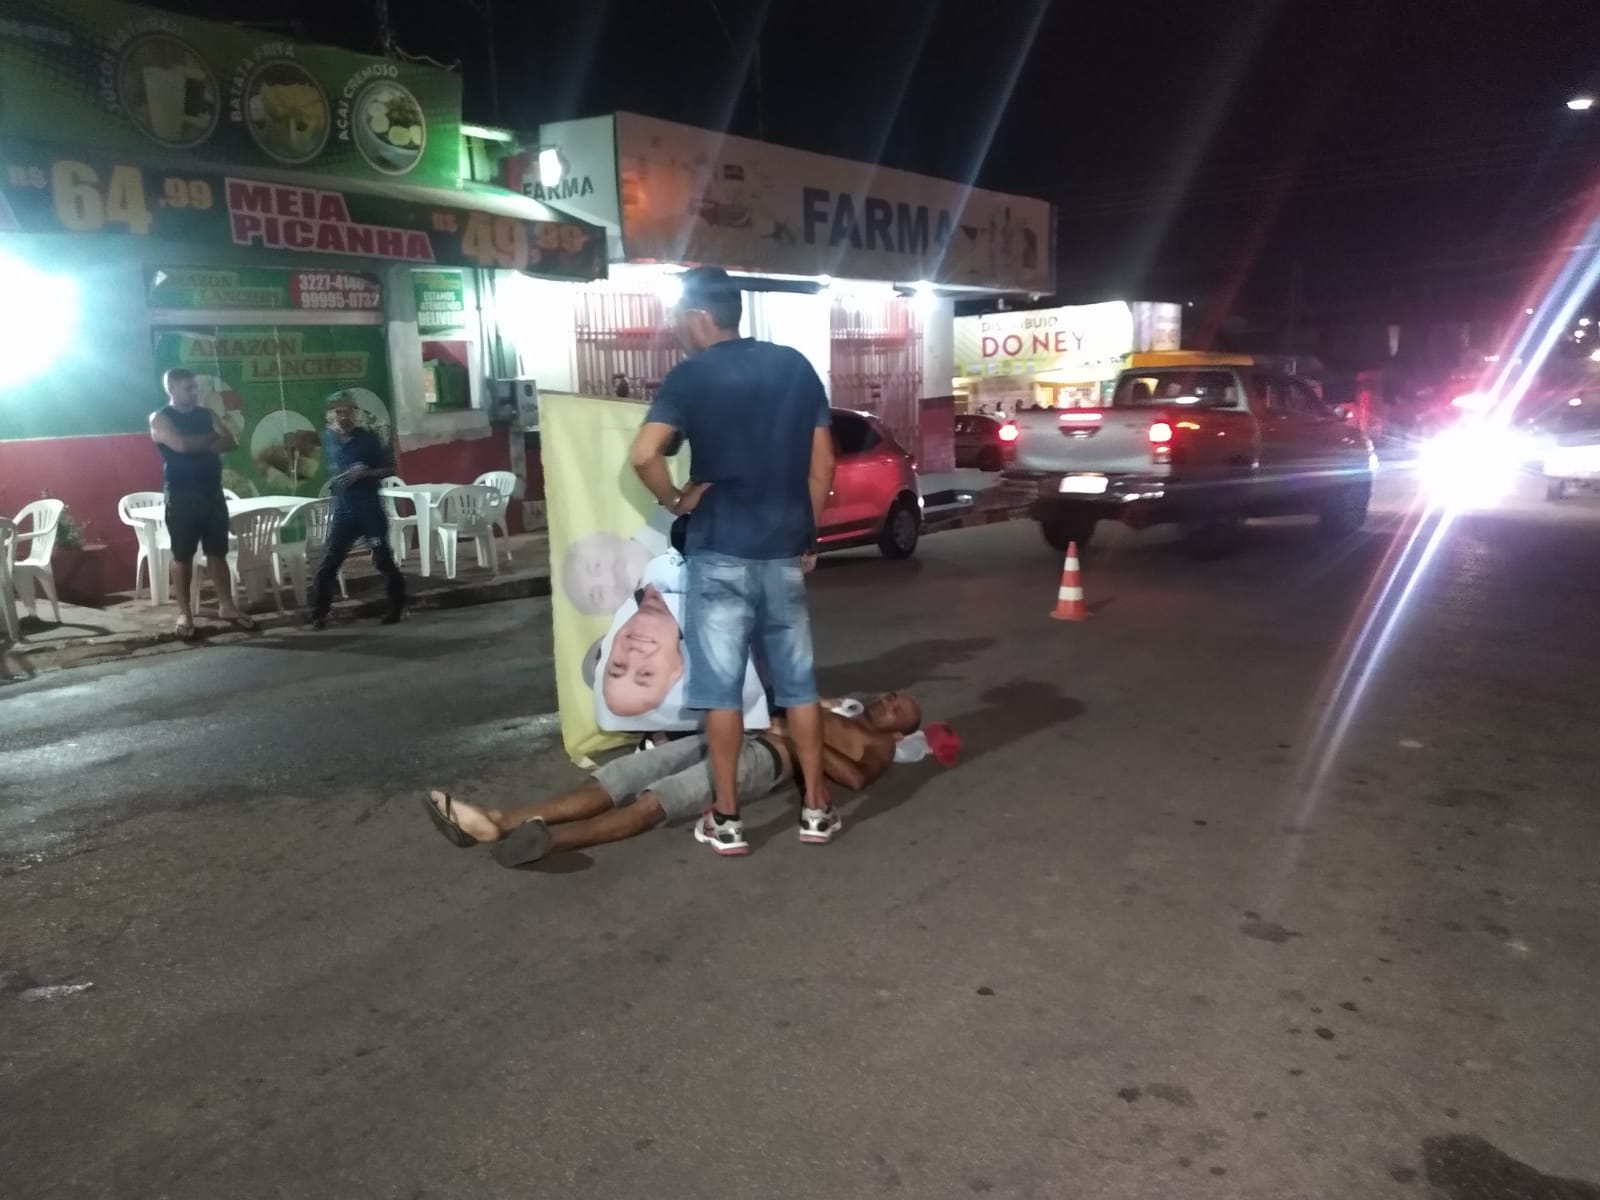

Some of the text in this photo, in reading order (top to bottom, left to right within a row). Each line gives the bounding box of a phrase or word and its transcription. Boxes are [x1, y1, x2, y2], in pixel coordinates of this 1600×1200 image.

[343, 63, 398, 98] CREMOSO
[228, 182, 350, 224] MEIA
[523, 175, 594, 201] FARMA
[233, 213, 435, 261] PICANHA
[803, 184, 956, 257] FARMA
[190, 337, 297, 357] AMAZON
[251, 356, 362, 378] LANCHES
